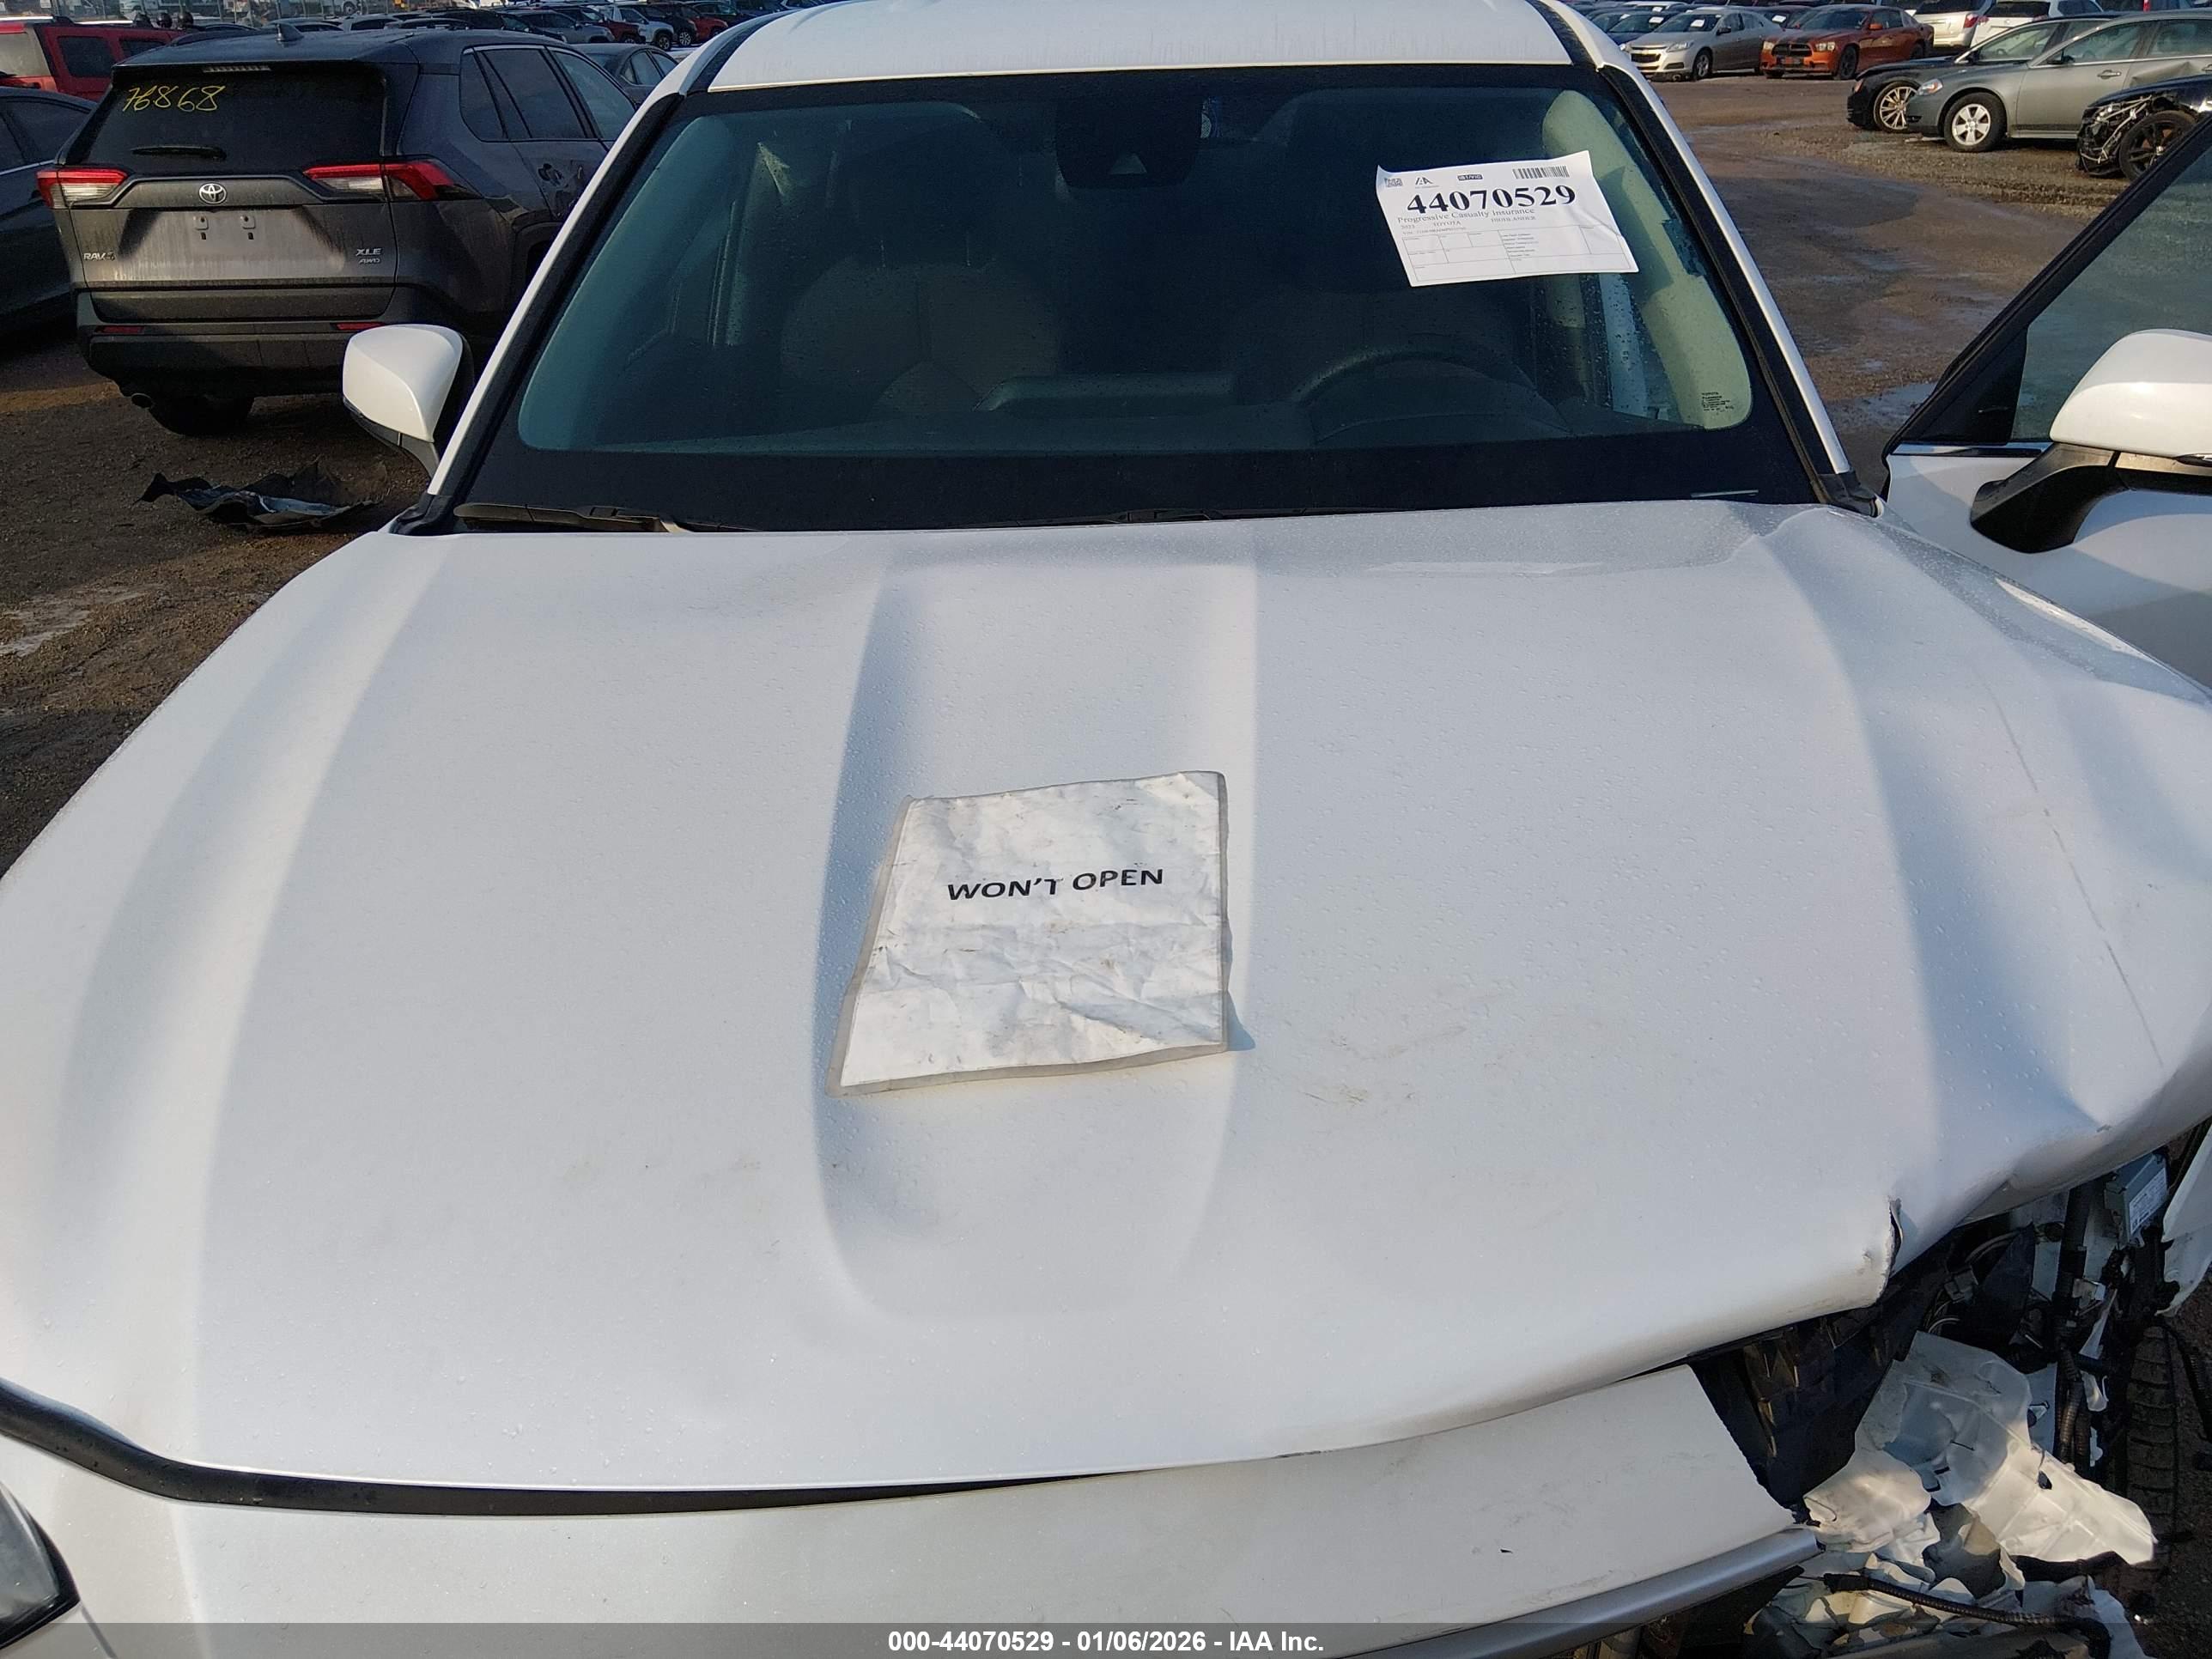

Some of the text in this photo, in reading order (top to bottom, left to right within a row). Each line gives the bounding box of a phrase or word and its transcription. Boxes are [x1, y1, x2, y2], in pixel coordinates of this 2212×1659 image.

[1407, 185, 1576, 214] 44070529
[1397, 208, 1535, 224] Progressive Casualty Insurance
[947, 869, 1163, 901] WON'T OPEN
